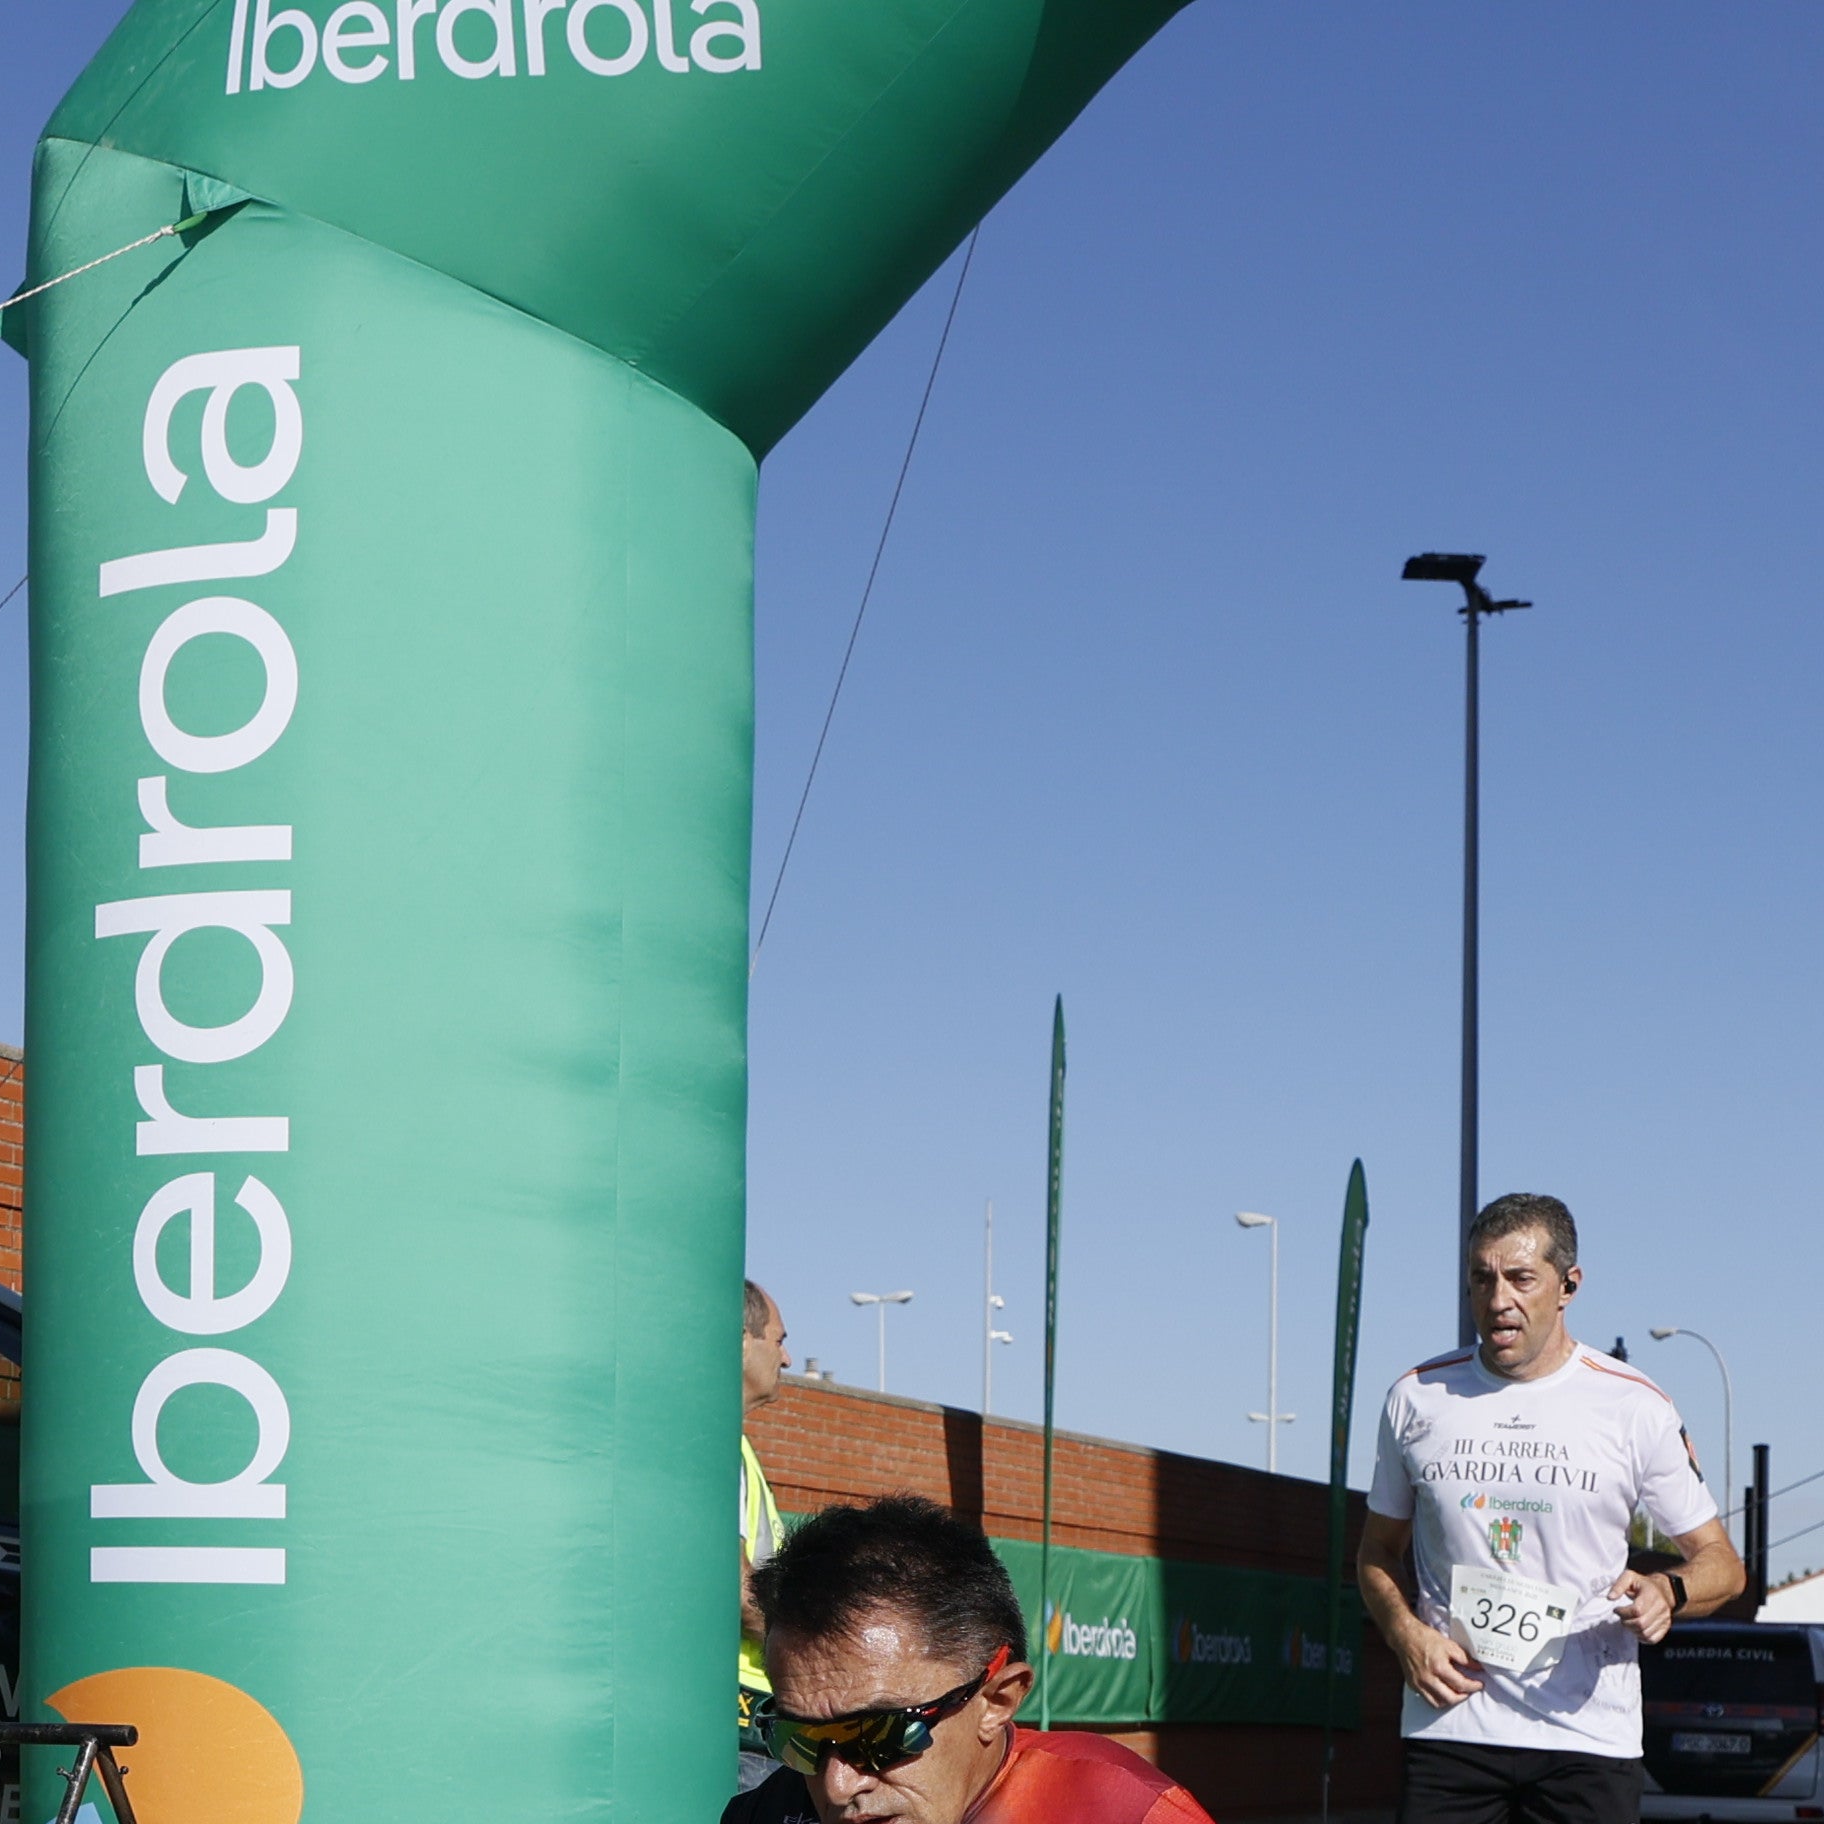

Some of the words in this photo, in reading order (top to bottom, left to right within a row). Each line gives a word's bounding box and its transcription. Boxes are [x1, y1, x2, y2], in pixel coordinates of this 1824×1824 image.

[225, 0, 762, 95] Iberdrola
[90, 345, 302, 1586] Iberdrola
[1454, 1439, 1474, 1455] III
[1481, 1440, 1570, 1461] CARRERA
[1422, 1460, 1524, 1484] GVARDIA
[1534, 1464, 1601, 1495] CIVIL
[1489, 1496, 1554, 1514] Iberdrola
[1470, 1598, 1542, 1642] 326
